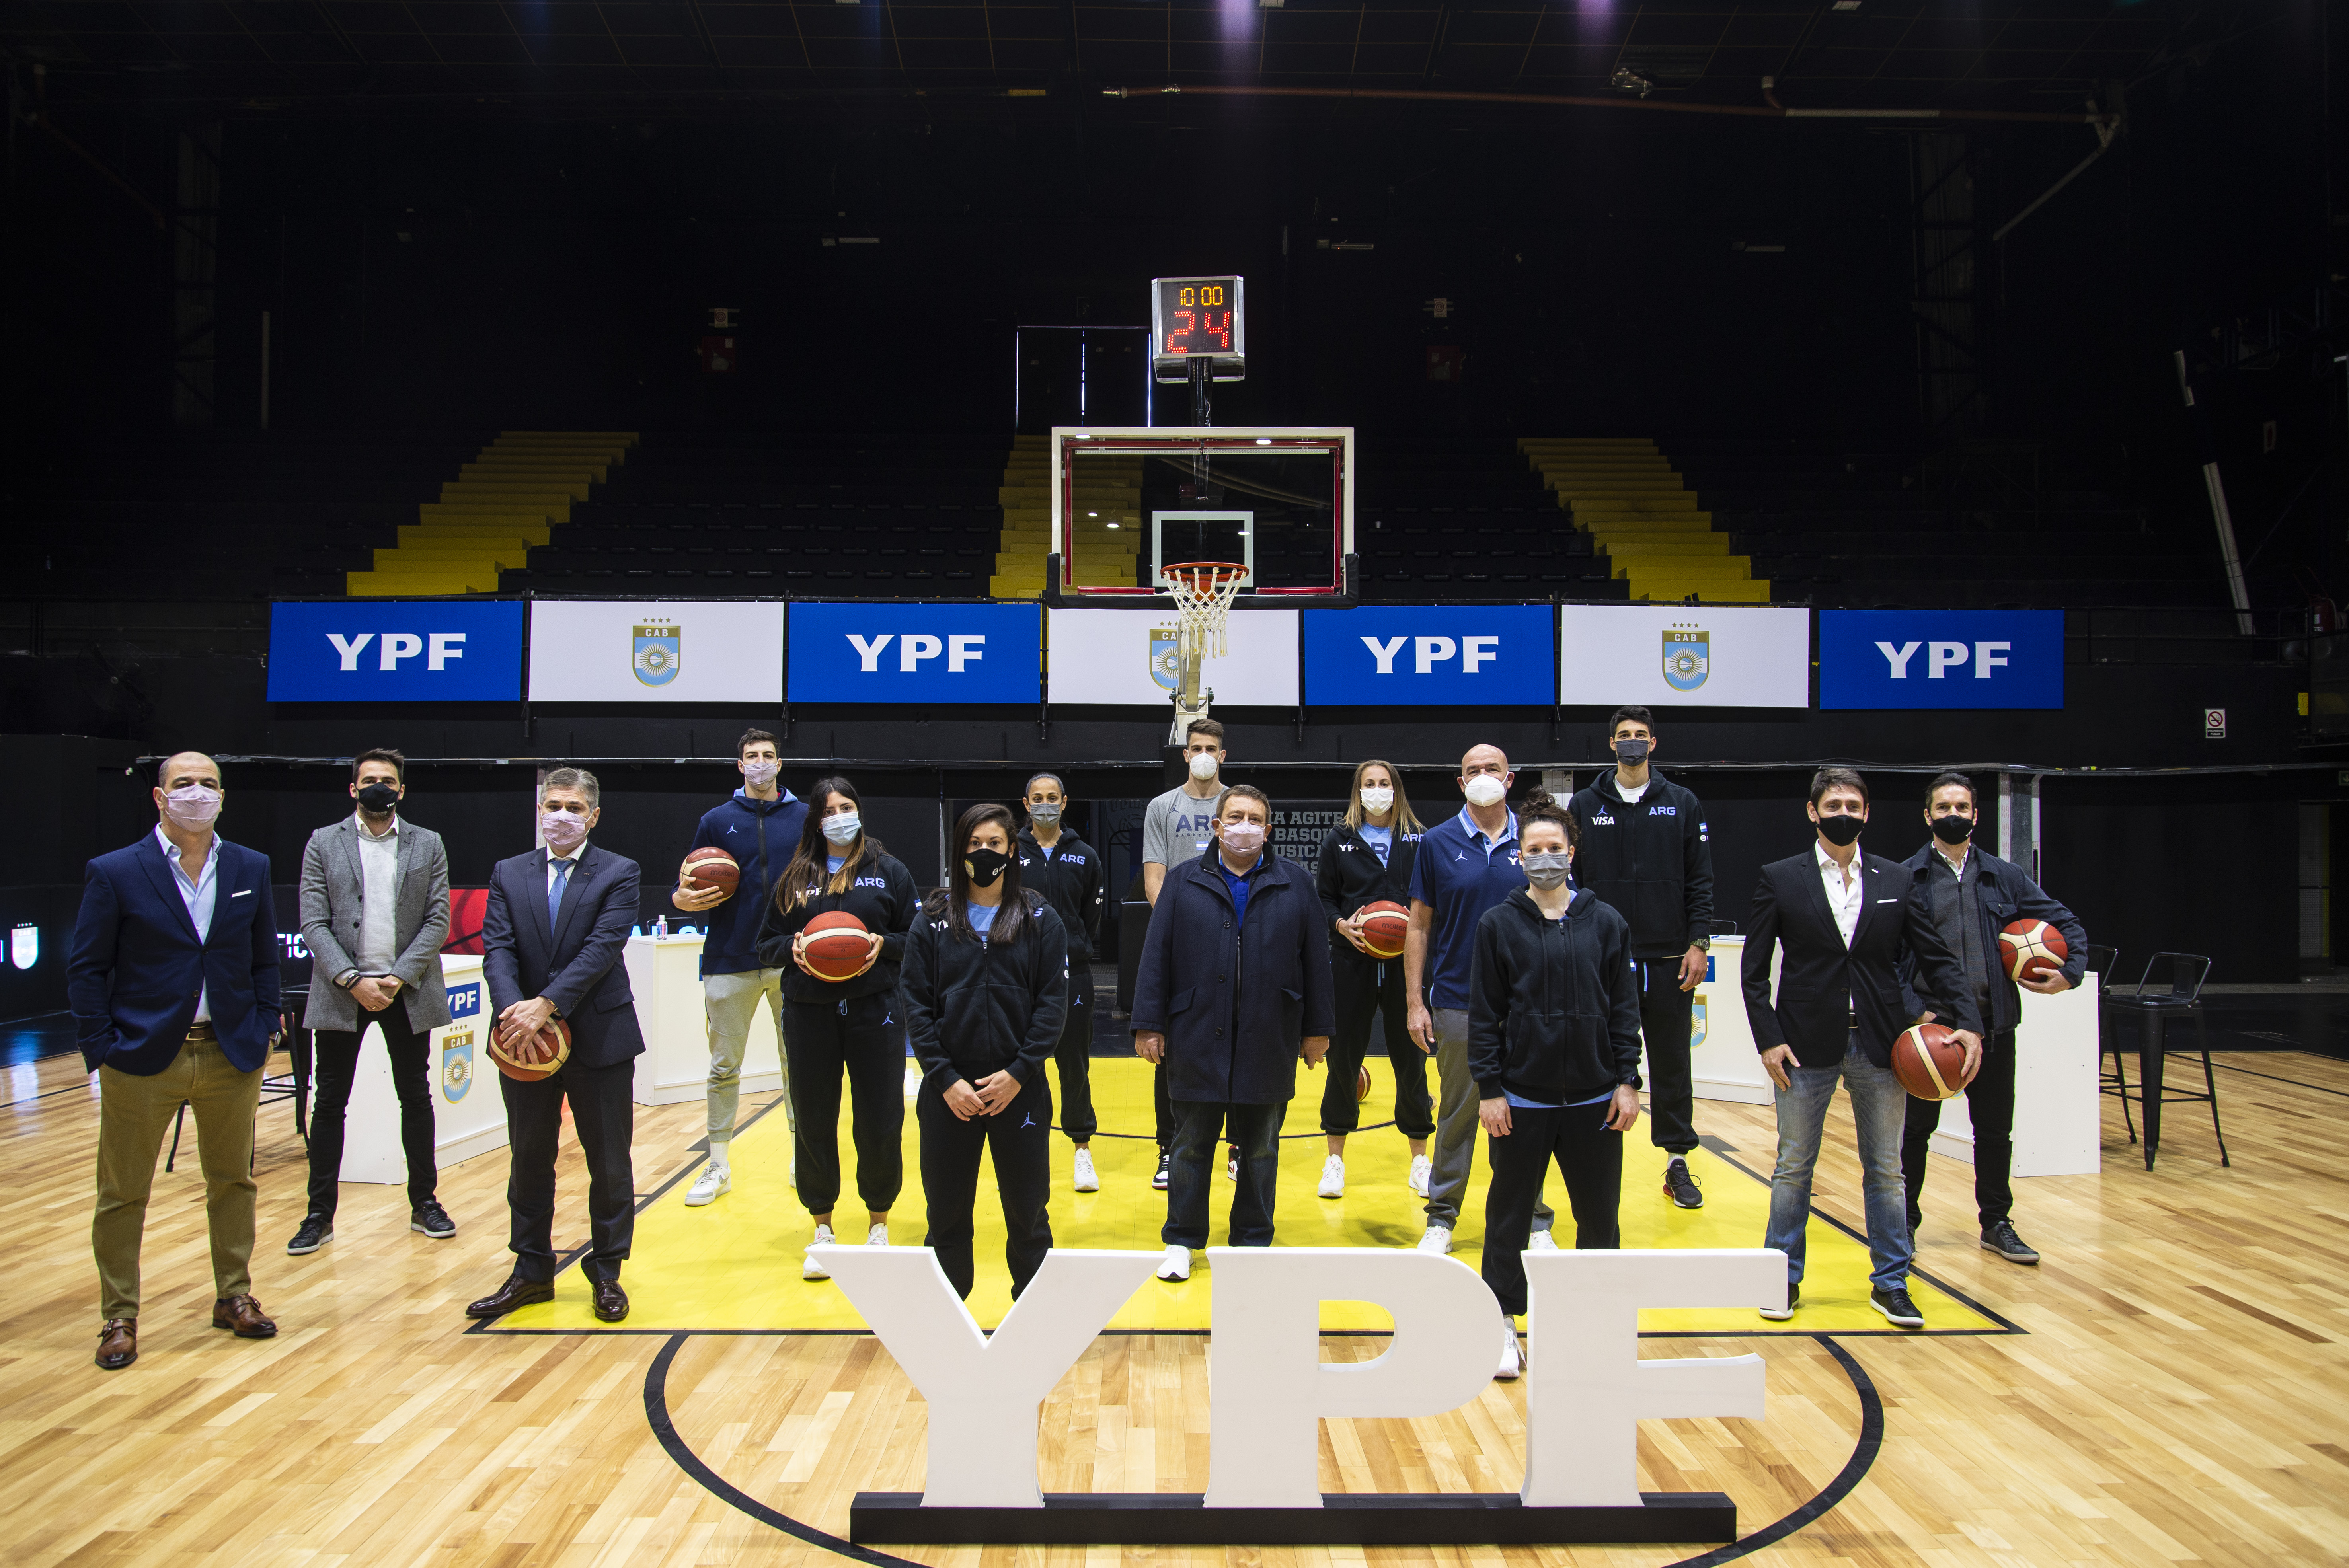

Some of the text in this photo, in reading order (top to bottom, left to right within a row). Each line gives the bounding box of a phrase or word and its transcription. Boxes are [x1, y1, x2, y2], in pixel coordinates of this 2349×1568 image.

[1180, 286, 1223, 307] 10 00
[1167, 310, 1230, 353] 24
[645, 629, 669, 637] CAB
[1162, 632, 1177, 640] CA
[1675, 633, 1697, 642] CAB
[325, 633, 466, 671] YPF
[844, 634, 986, 672] YPF
[1359, 636, 1499, 674] YPF
[1874, 641, 2011, 679] YPF
[1649, 806, 1676, 816] ARG
[1290, 811, 1344, 824] AGITE
[1590, 816, 1615, 825] VISA
[1272, 844, 1321, 857] USIC
[1059, 853, 1086, 865] ARG
[854, 877, 885, 888] ARG
[1382, 923, 1406, 932] molten
[451, 1036, 466, 1048] CAB
[805, 1245, 1788, 1508] YPF
